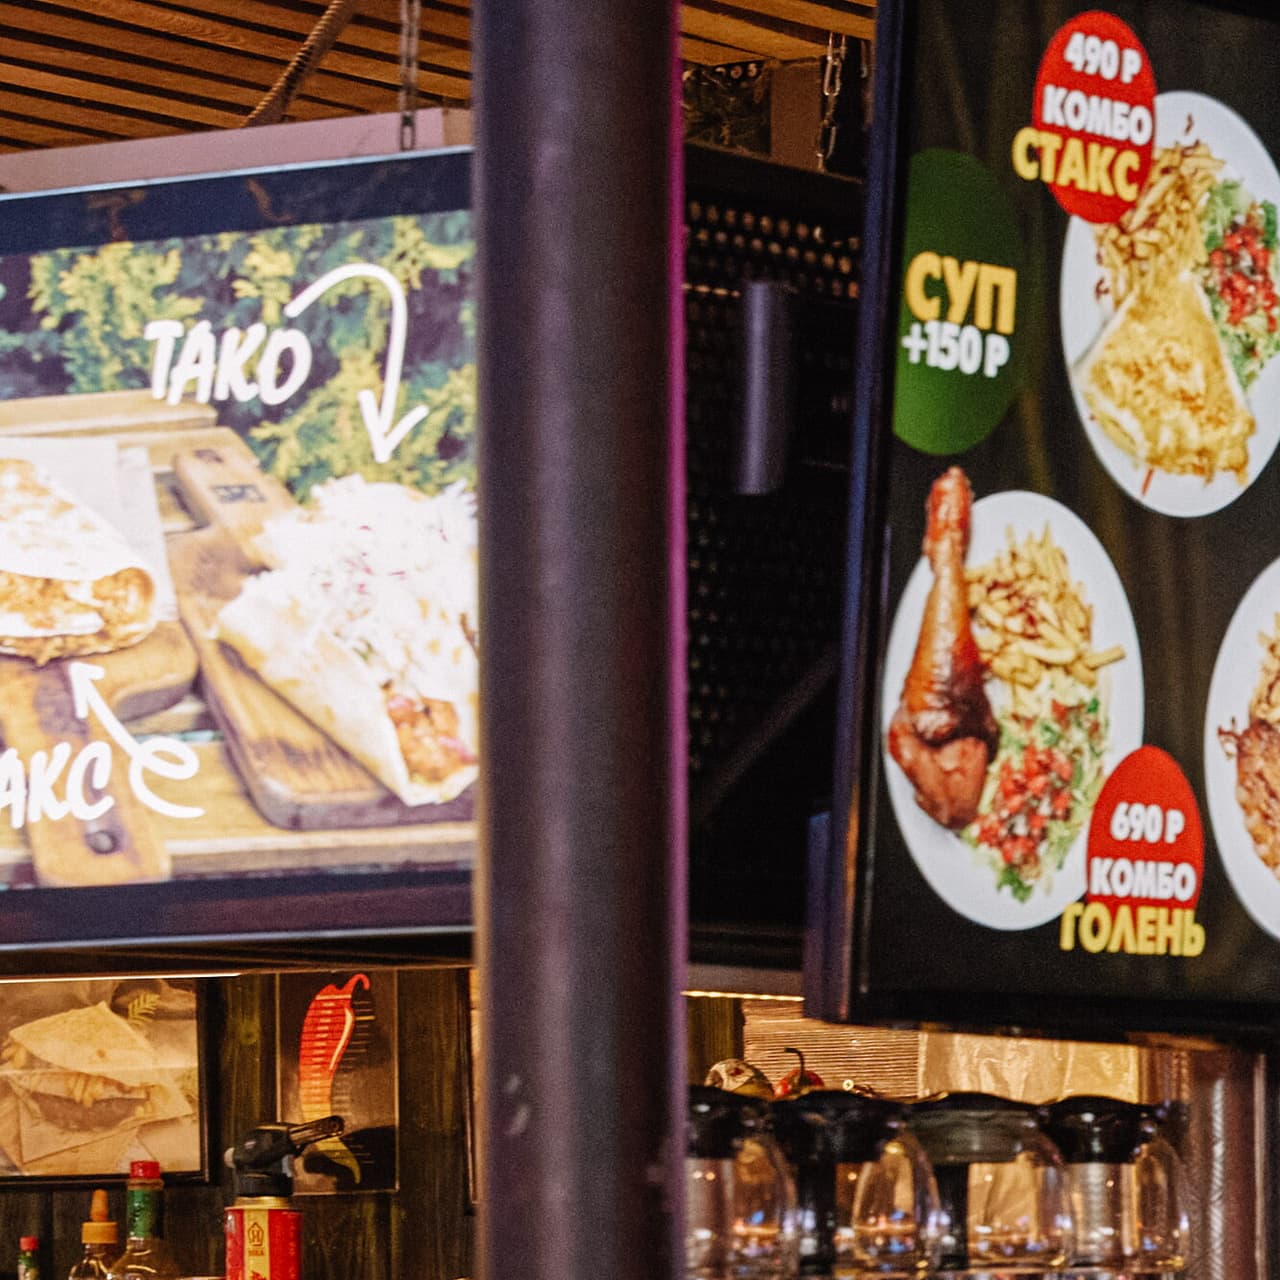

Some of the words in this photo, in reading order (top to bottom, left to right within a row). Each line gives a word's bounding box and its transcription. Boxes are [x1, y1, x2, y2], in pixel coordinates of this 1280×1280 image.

[1063, 31, 1120, 80] 490
[1120, 48, 1143, 84] Р
[1041, 84, 1153, 146] КОМБО
[1011, 126, 1140, 201] СТАКС
[904, 250, 1017, 336] СУП
[144, 319, 312, 407] ТАКО
[901, 319, 983, 375] +150
[983, 333, 1010, 378] Р
[1110, 801, 1163, 844] 690
[1164, 809, 1185, 844] Р
[1089, 857, 1197, 902] КОМБО
[1060, 902, 1206, 957] ГОЛЕНЬ
